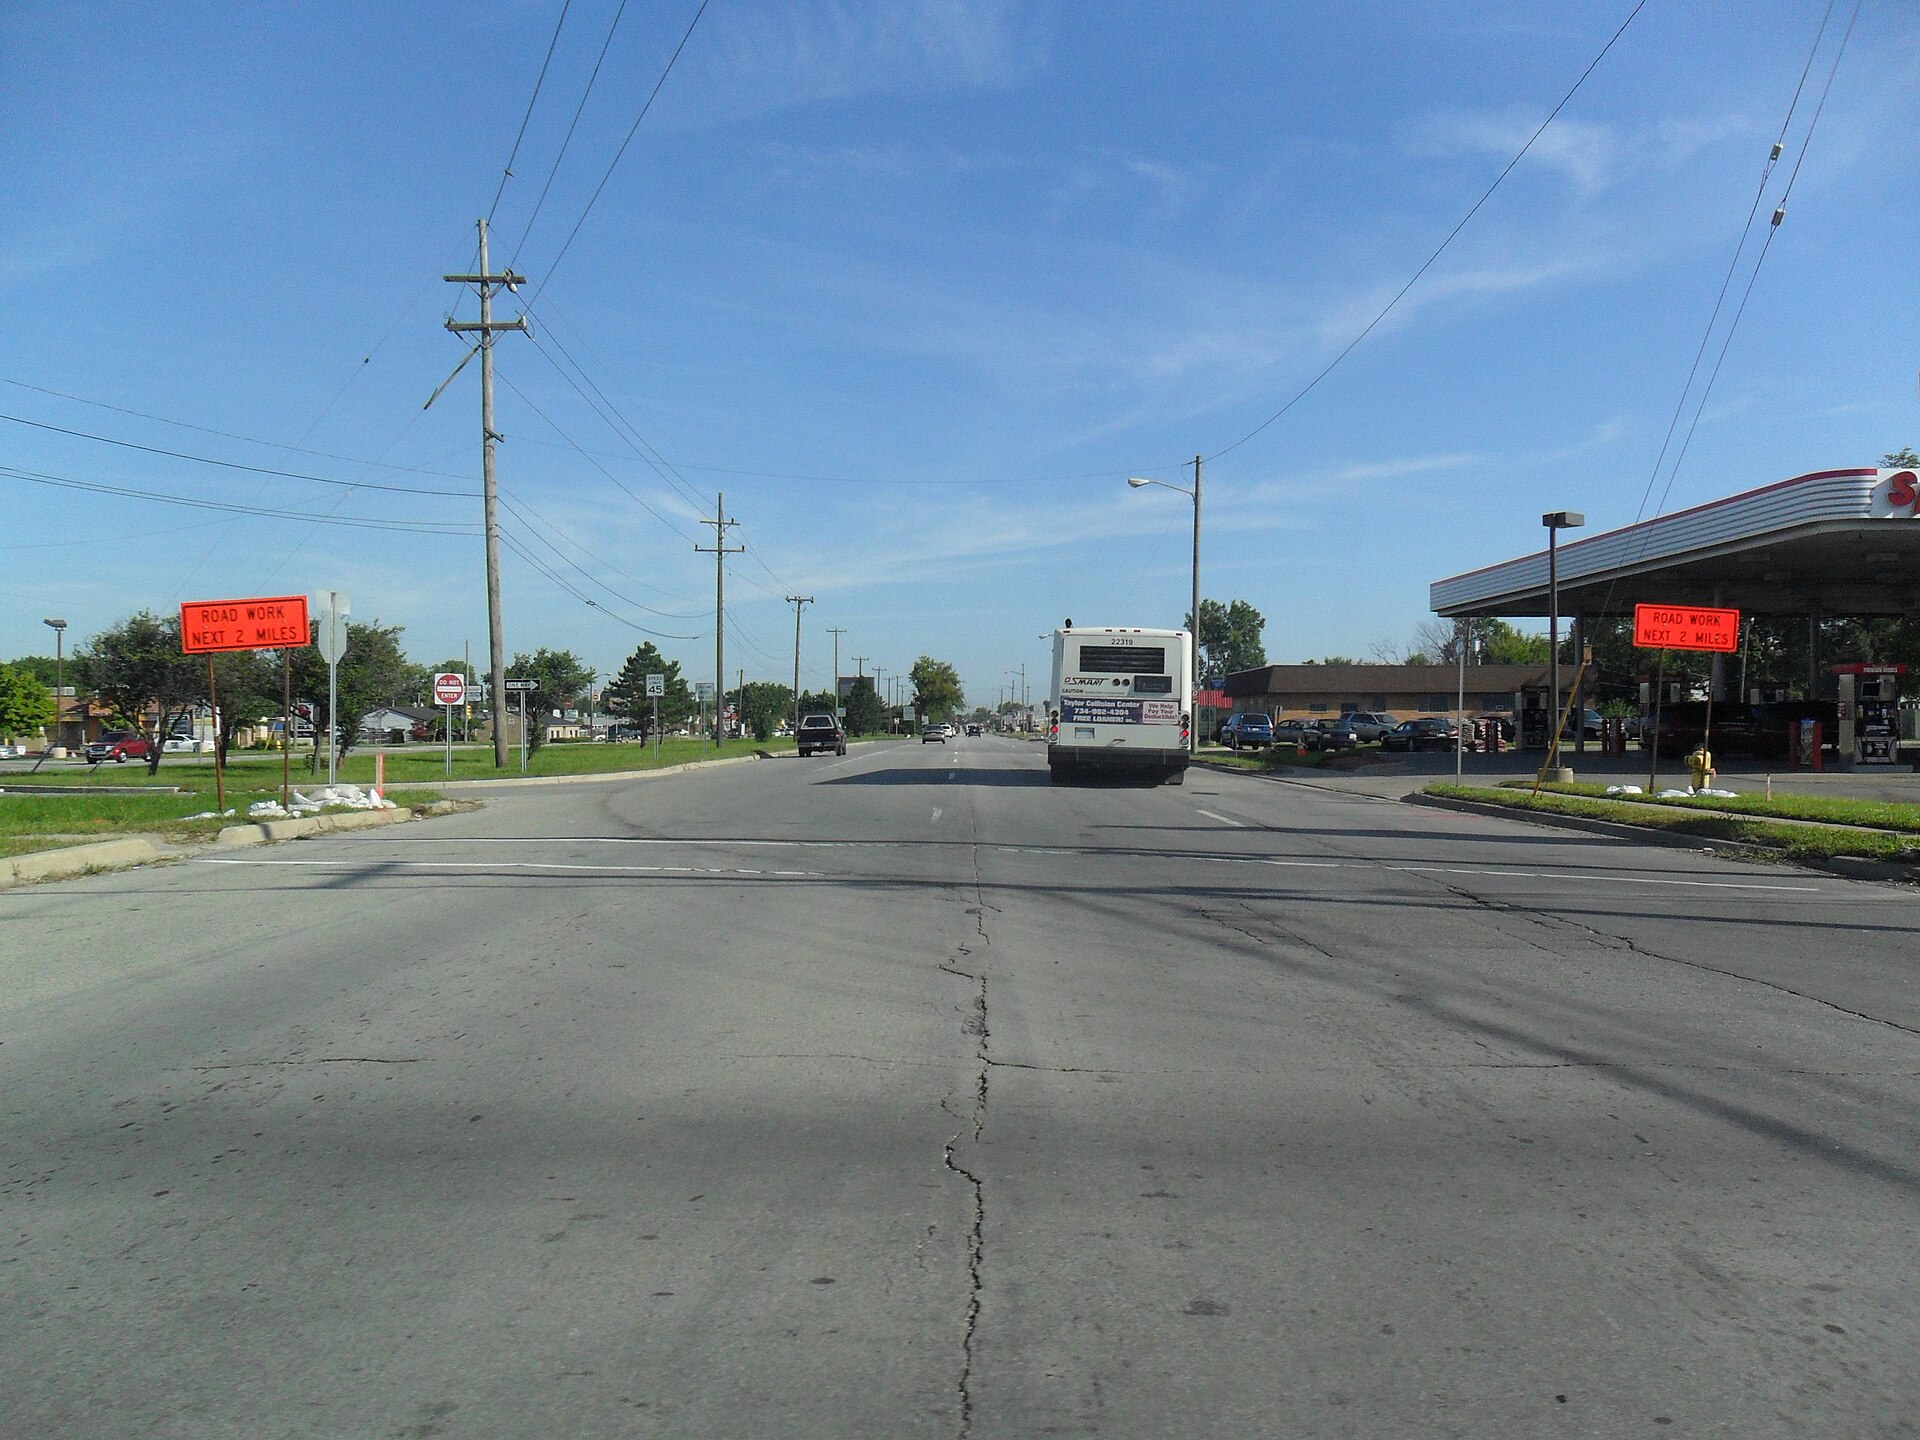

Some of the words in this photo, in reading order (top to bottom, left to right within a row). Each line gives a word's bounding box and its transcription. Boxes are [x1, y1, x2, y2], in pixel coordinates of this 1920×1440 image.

[201, 608, 238, 623] ROAD
[246, 606, 285, 620] WORK
[1653, 612, 1683, 625] ROAD
[1689, 614, 1721, 627] WORK
[192, 630, 225, 645] NEXT
[236, 629, 244, 643] 2
[256, 627, 297, 641] MILES
[1643, 629, 1671, 641] NEXT
[1679, 631, 1687, 642] 2
[1695, 632, 1728, 645] MILES
[1069, 677, 1109, 686] SMART
[648, 686, 662, 694] 45
[1063, 699, 1085, 707] Taylor
